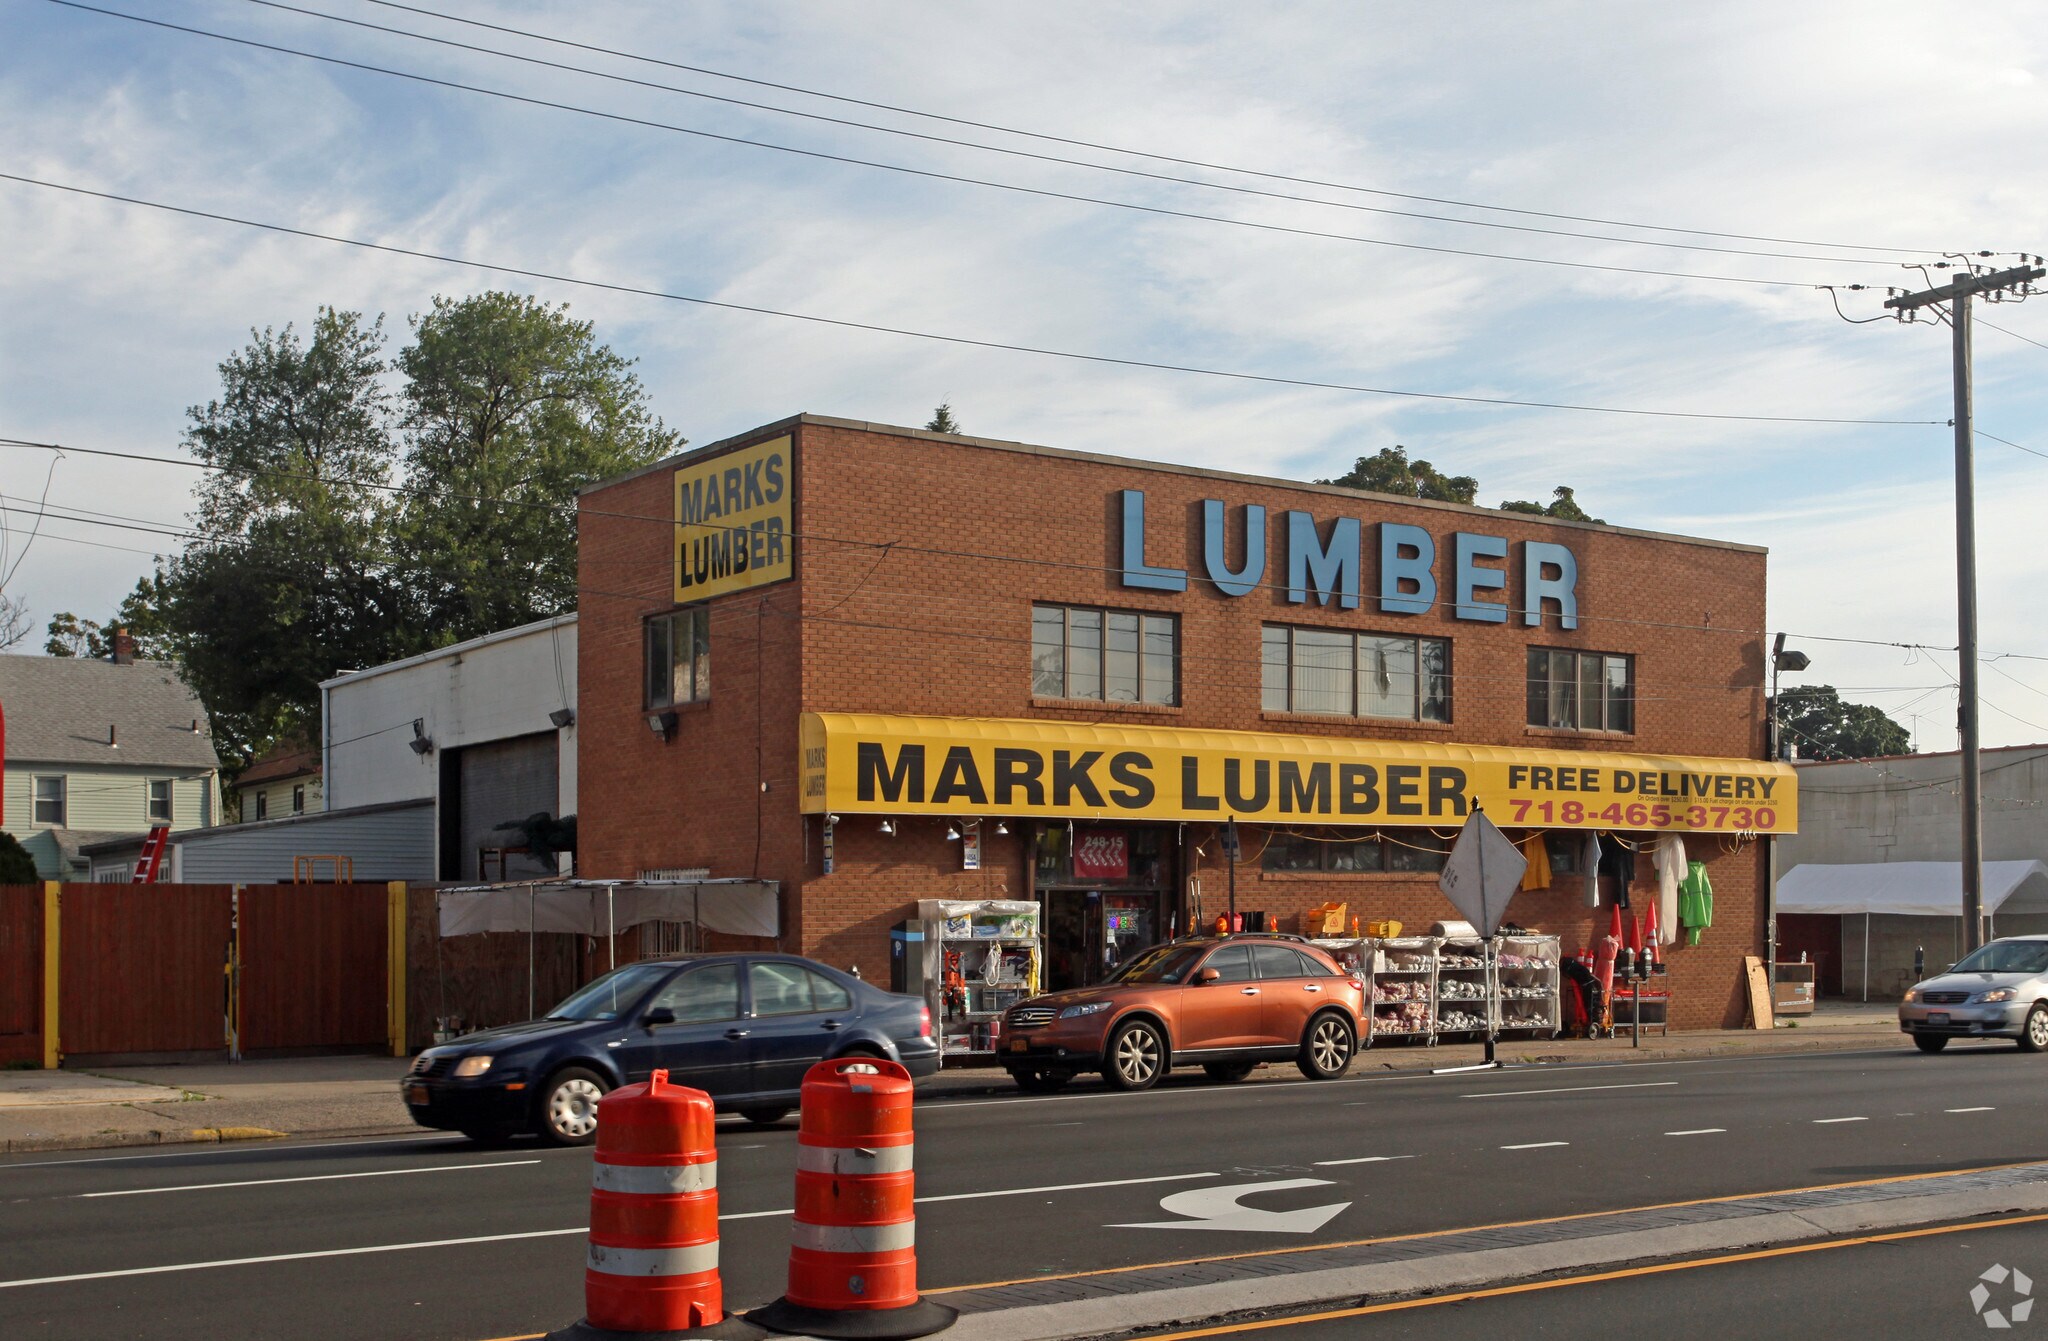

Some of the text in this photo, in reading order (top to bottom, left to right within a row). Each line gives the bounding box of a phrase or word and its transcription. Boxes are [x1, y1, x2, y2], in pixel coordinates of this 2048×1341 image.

[681, 453, 784, 528] MARKS
[681, 516, 784, 588] LUMBER
[1121, 489, 1579, 630] LUMBER
[857, 741, 1467, 816] MARKS LUMBER
[1509, 765, 1777, 799] FREE DELIVERY
[1510, 799, 1776, 829] 718-465-3730
[1084, 836, 1124, 847] 248-15
